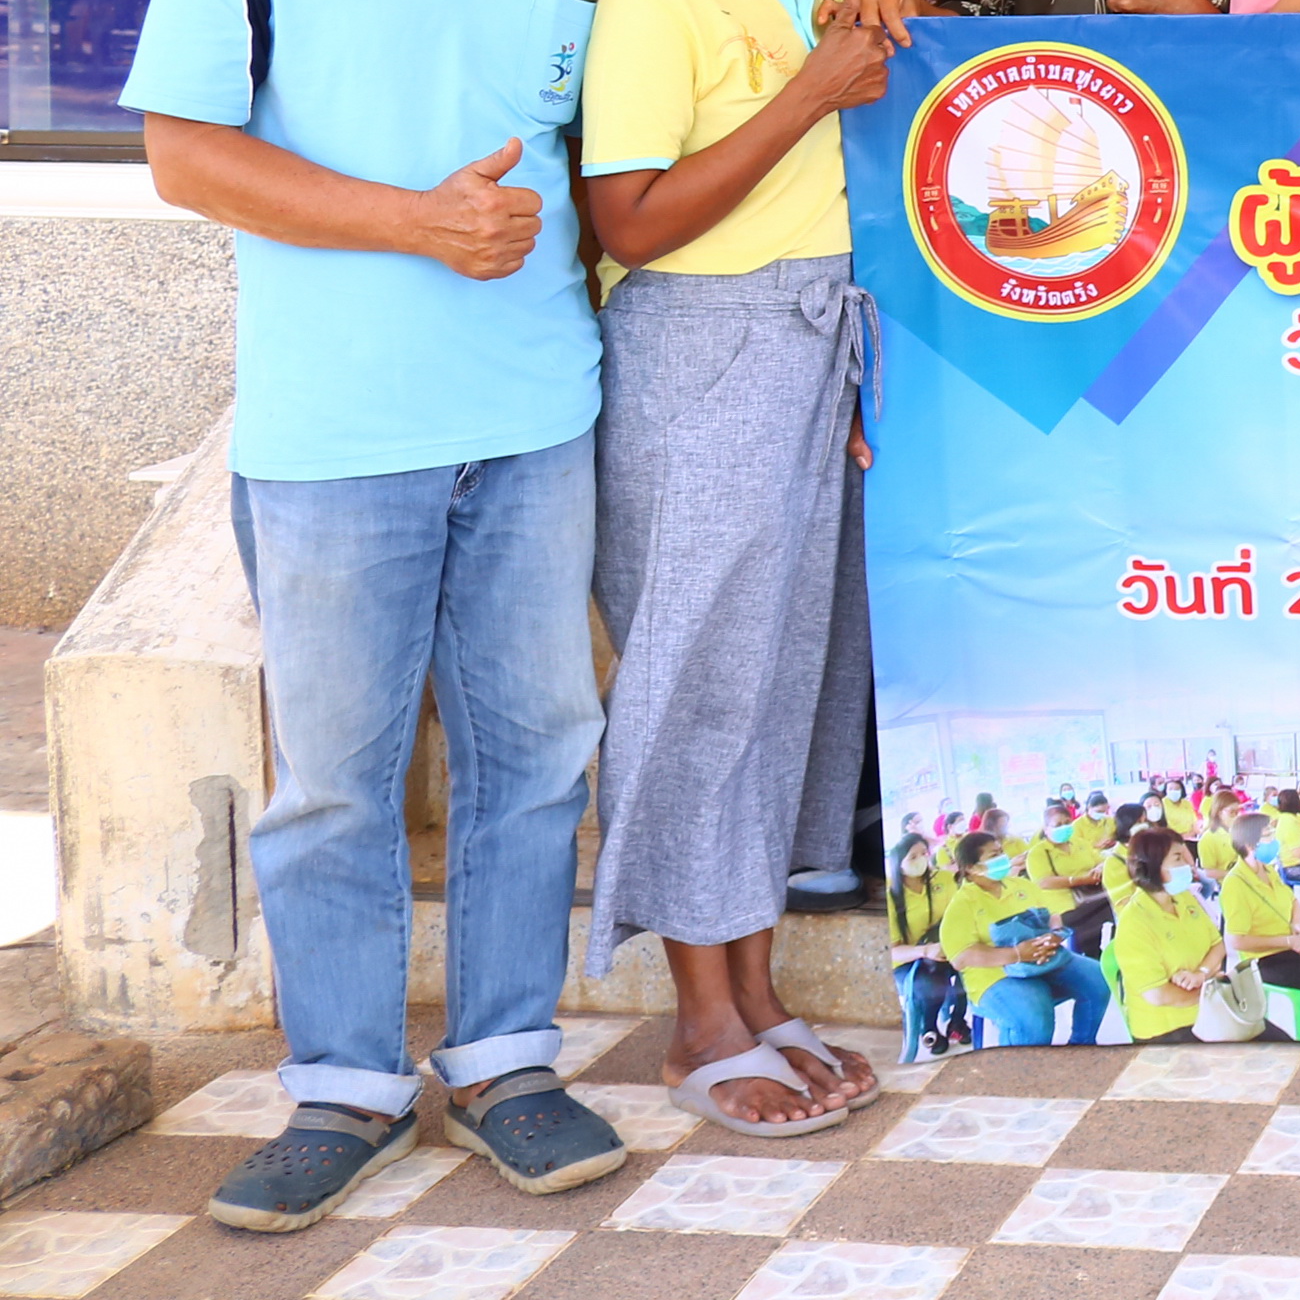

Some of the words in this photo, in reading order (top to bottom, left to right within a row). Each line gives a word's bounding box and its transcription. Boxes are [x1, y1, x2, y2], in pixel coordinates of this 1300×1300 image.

[946, 56, 1135, 119] เทศบาลตำบลทุ่งยาว
[1000, 277, 1099, 307] จังหวัดตรัง
[1122, 549, 1253, 615] วันที่
